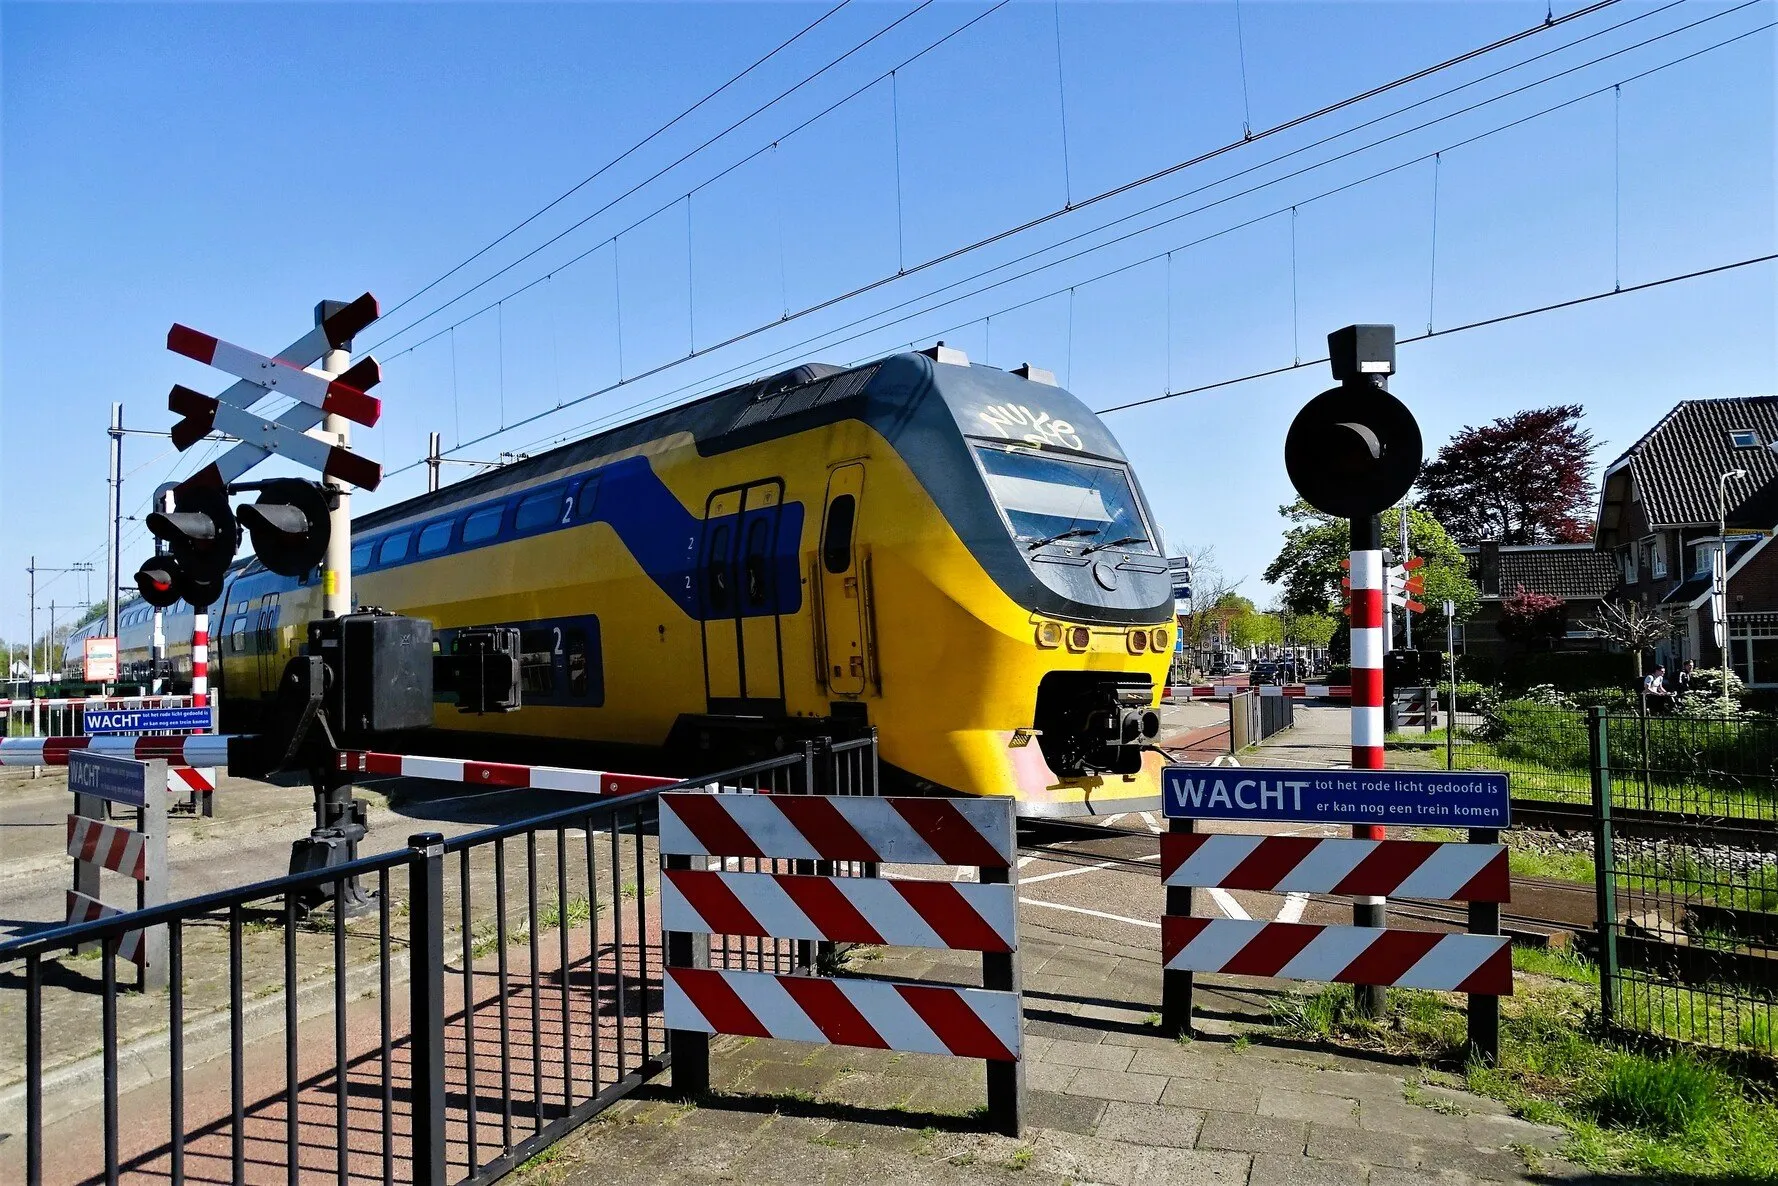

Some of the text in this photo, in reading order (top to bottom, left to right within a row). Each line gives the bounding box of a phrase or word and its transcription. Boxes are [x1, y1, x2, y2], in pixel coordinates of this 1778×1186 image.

[562, 496, 573, 524] 2
[688, 537, 694, 550] 2
[685, 576, 691, 589] 2
[553, 627, 563, 655] 2
[87, 714, 141, 728] WACHT
[71, 761, 100, 788] WACHT
[1172, 778, 1310, 810] WACHT
[1315, 780, 1498, 795] tot het rode licht gedoofd is
[1316, 802, 1499, 816] er kan nog een trein komen
